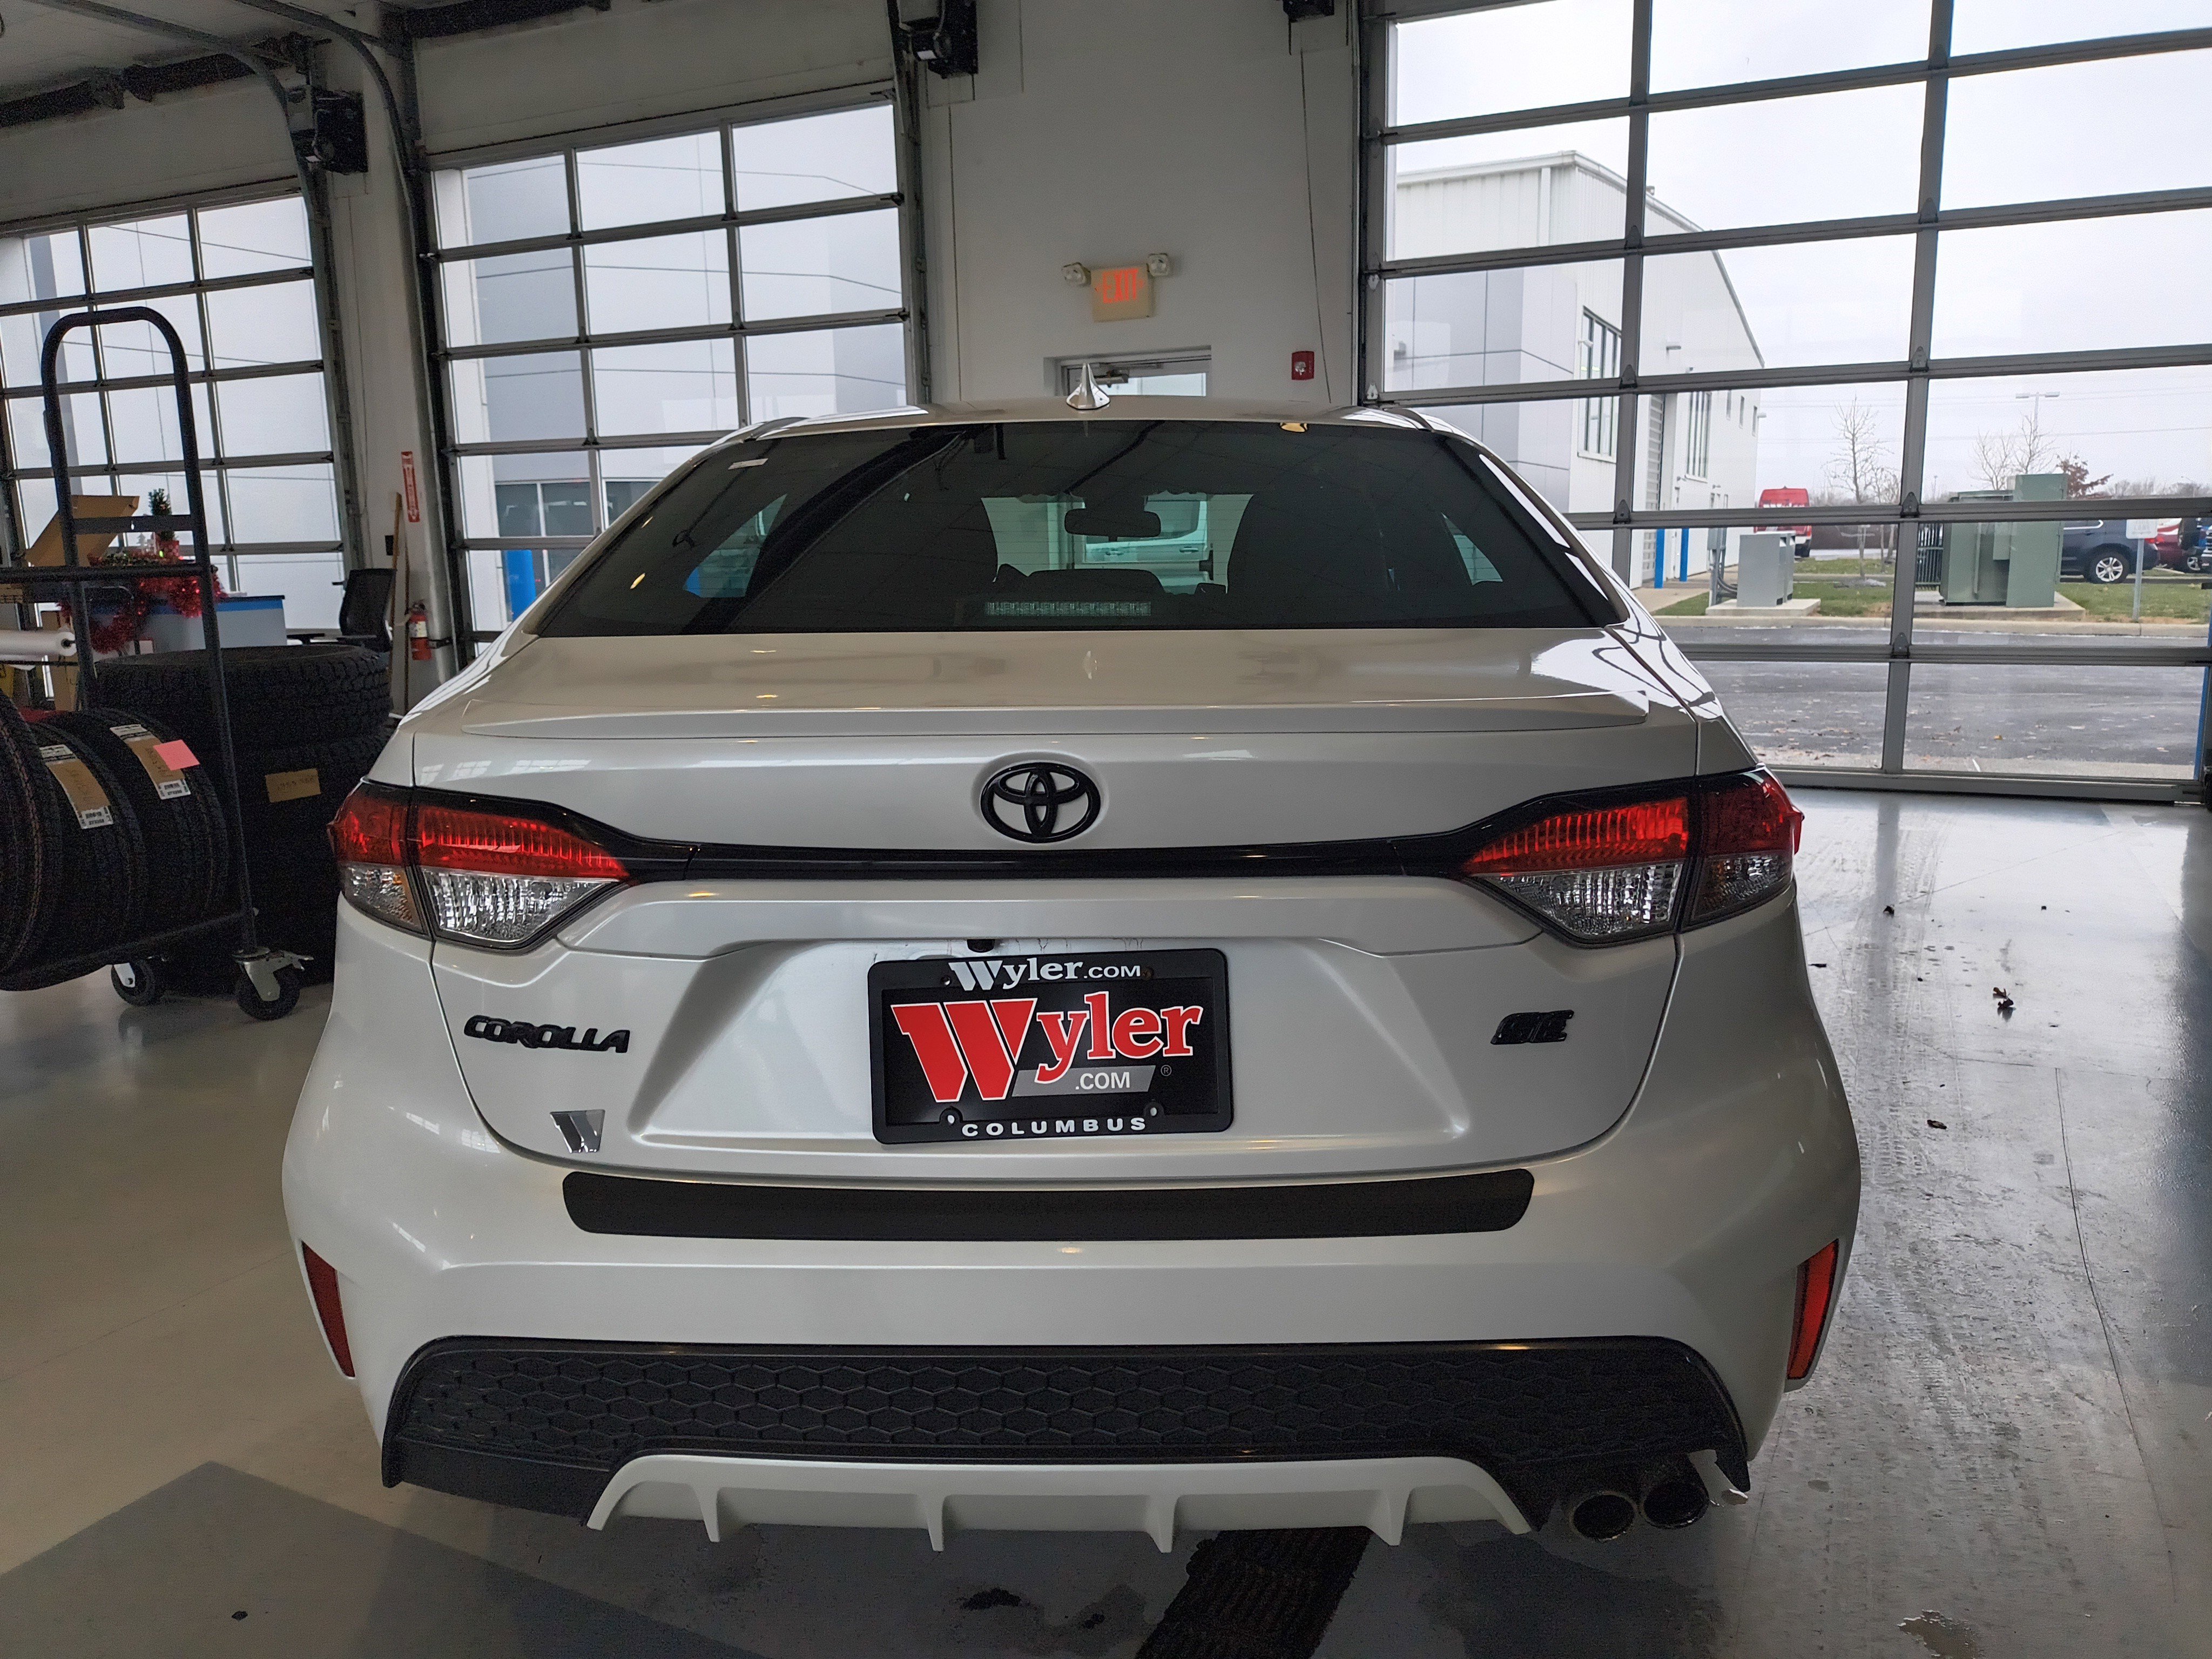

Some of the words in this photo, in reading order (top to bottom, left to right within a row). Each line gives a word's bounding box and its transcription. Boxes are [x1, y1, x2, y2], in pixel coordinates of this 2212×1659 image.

[1102, 267, 1138, 304] EXIT
[464, 1015, 630, 1053] COROLLA
[890, 991, 1204, 1103] Wyler
[1075, 1071, 1130, 1090] .COM
[962, 1117, 1146, 1137] COLUMBUS
